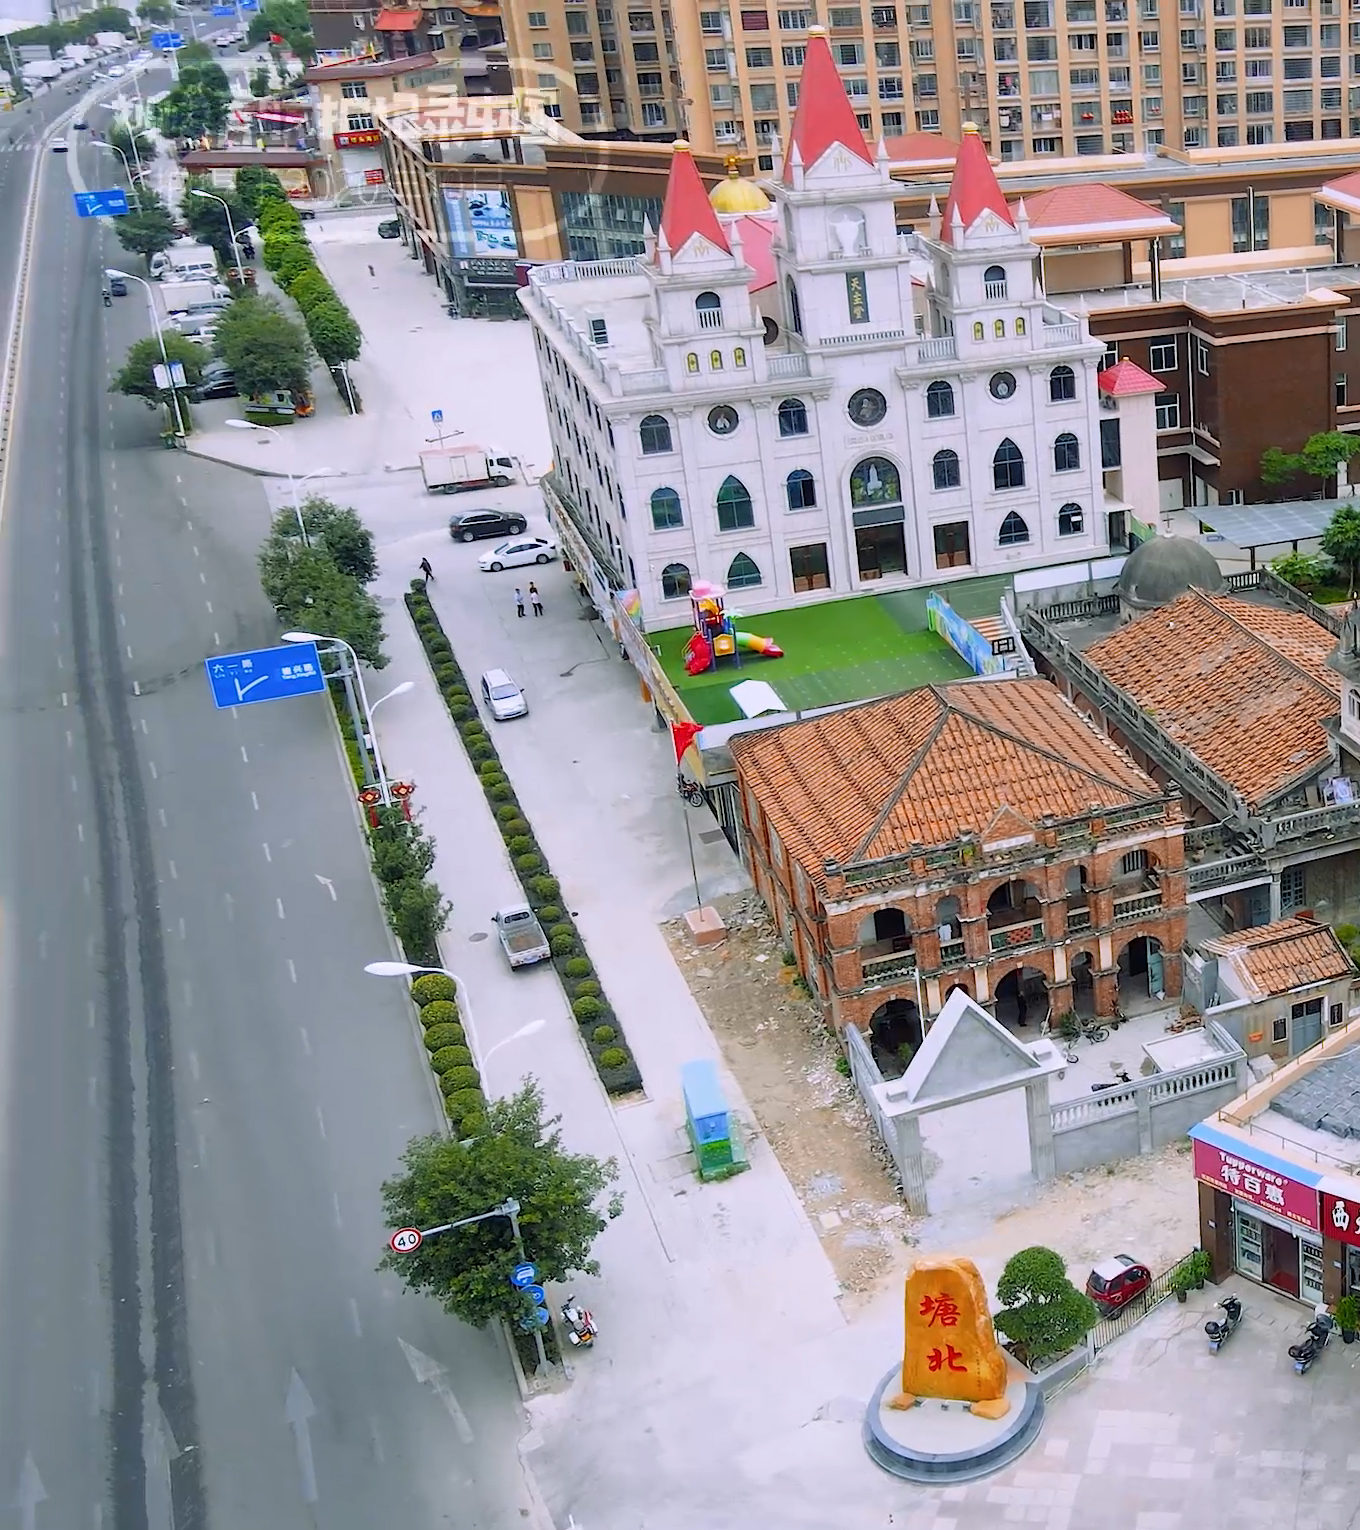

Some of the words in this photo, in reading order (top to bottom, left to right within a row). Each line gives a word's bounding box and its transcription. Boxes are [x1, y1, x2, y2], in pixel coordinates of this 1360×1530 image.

[1219, 1151, 1283, 1187] Tupperware
[1221, 1165, 1285, 1206] 特百惠
[397, 1232, 417, 1248] 40
[919, 1293, 968, 1373] 塘北
